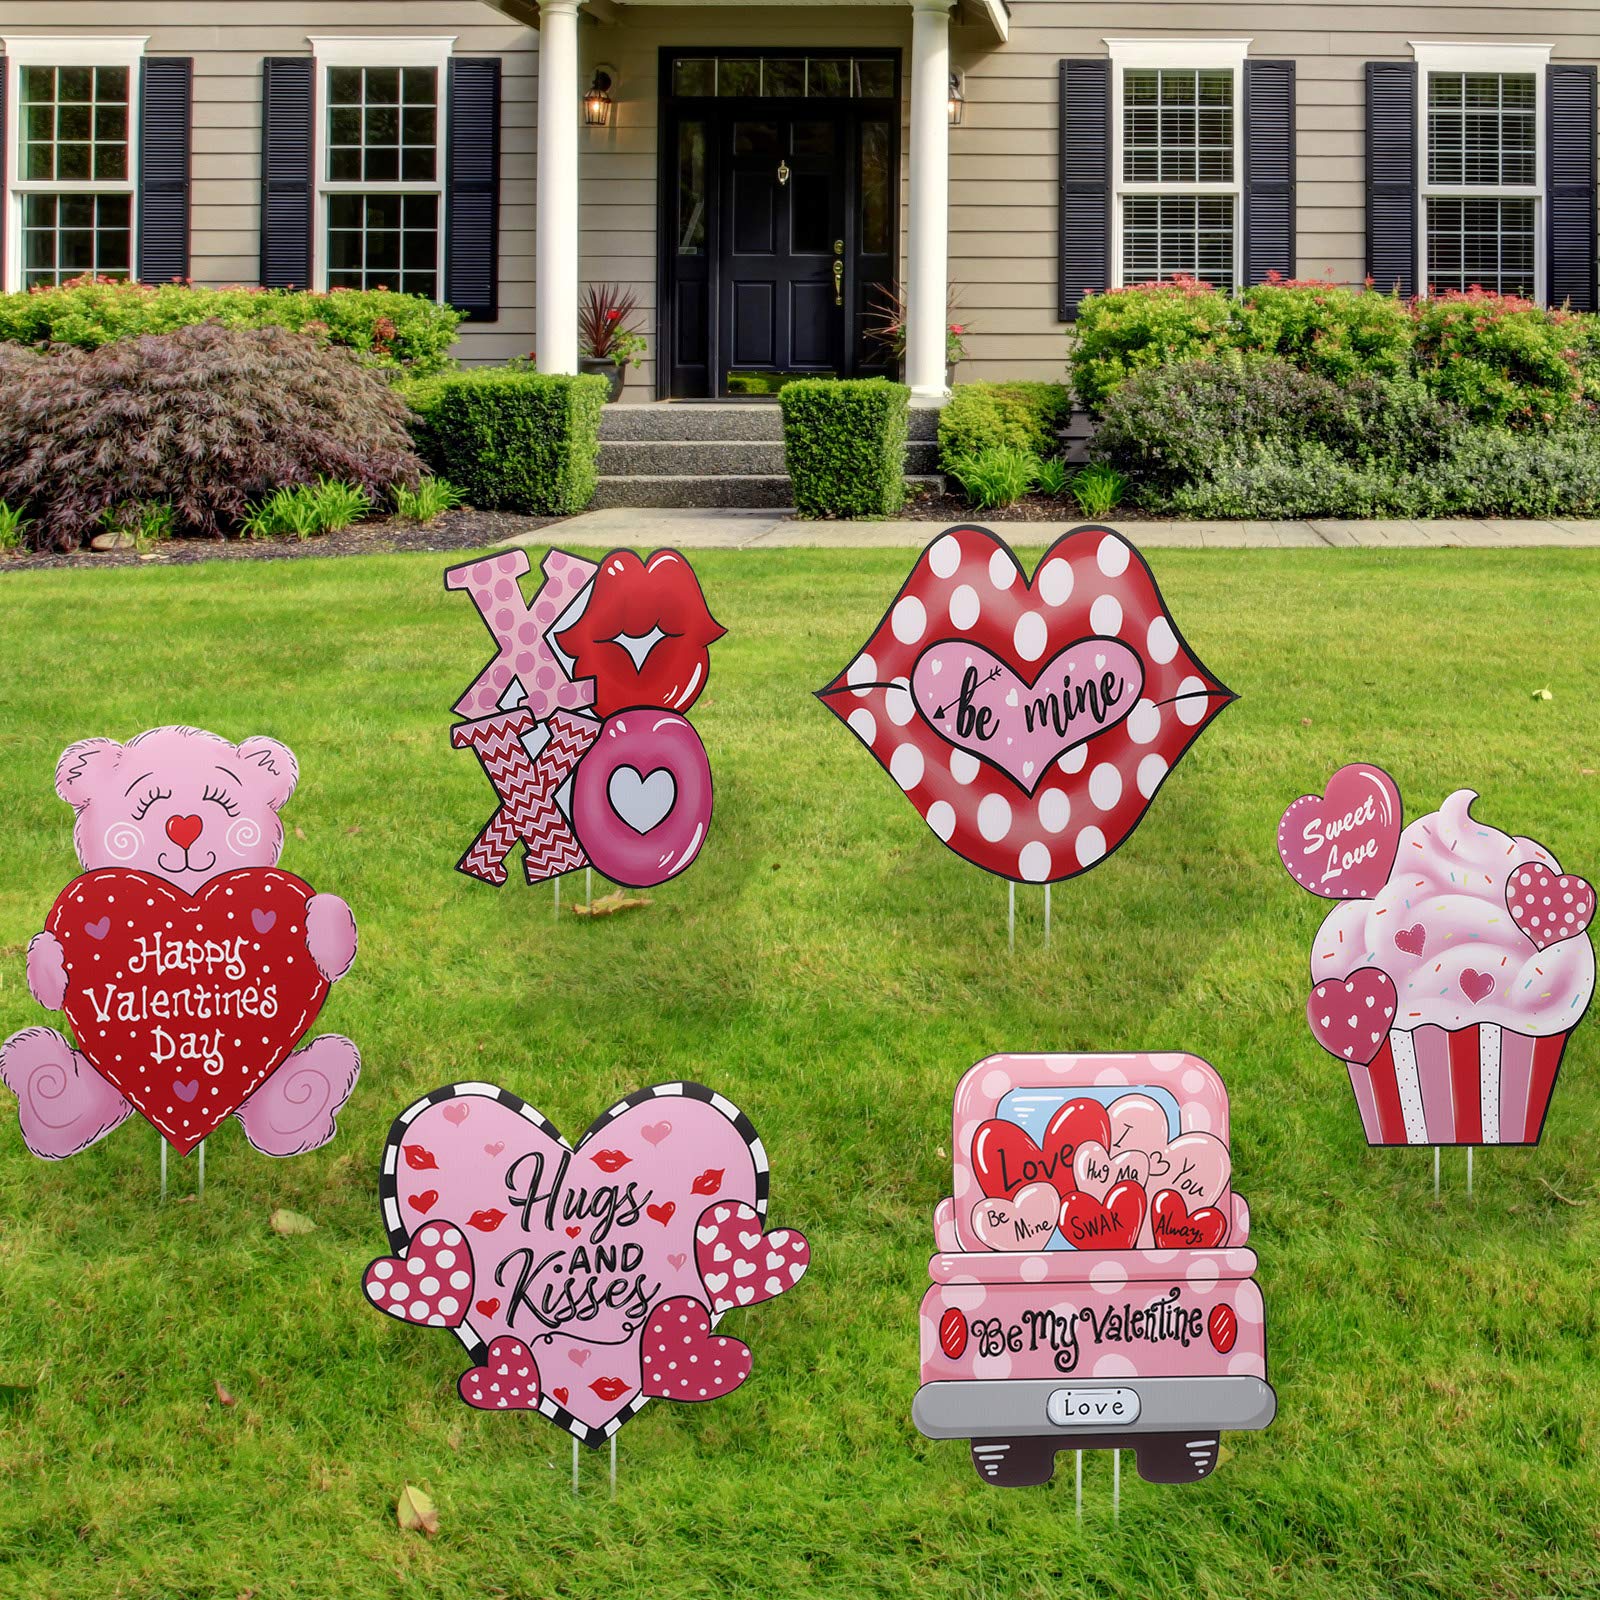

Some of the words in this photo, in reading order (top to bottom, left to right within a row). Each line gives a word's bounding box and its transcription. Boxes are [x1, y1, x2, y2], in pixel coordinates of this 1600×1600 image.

[956, 666, 1000, 741] be
[1024, 671, 1124, 738] mine
[1303, 794, 1375, 854] Sweet
[1320, 838, 1378, 883] Love
[128, 930, 249, 981] Happy
[82, 977, 278, 1022] Valentine's
[150, 1024, 225, 1076] Day
[997, 1143, 1074, 1192] Love
[1086, 1158, 1110, 1183] Hug
[1172, 1157, 1204, 1197] You
[504, 1149, 654, 1245] Hugs
[987, 1209, 1009, 1227] Be
[1014, 1217, 1053, 1242] Mine
[1070, 1211, 1124, 1240] SWAK
[1155, 1210, 1204, 1245] Always
[568, 1243, 644, 1275] AND
[494, 1247, 661, 1329] Kisses
[971, 1317, 1023, 1357] Be
[1021, 1308, 1080, 1373] My
[1079, 1286, 1204, 1347] Valentine
[1064, 1398, 1125, 1416] Love
